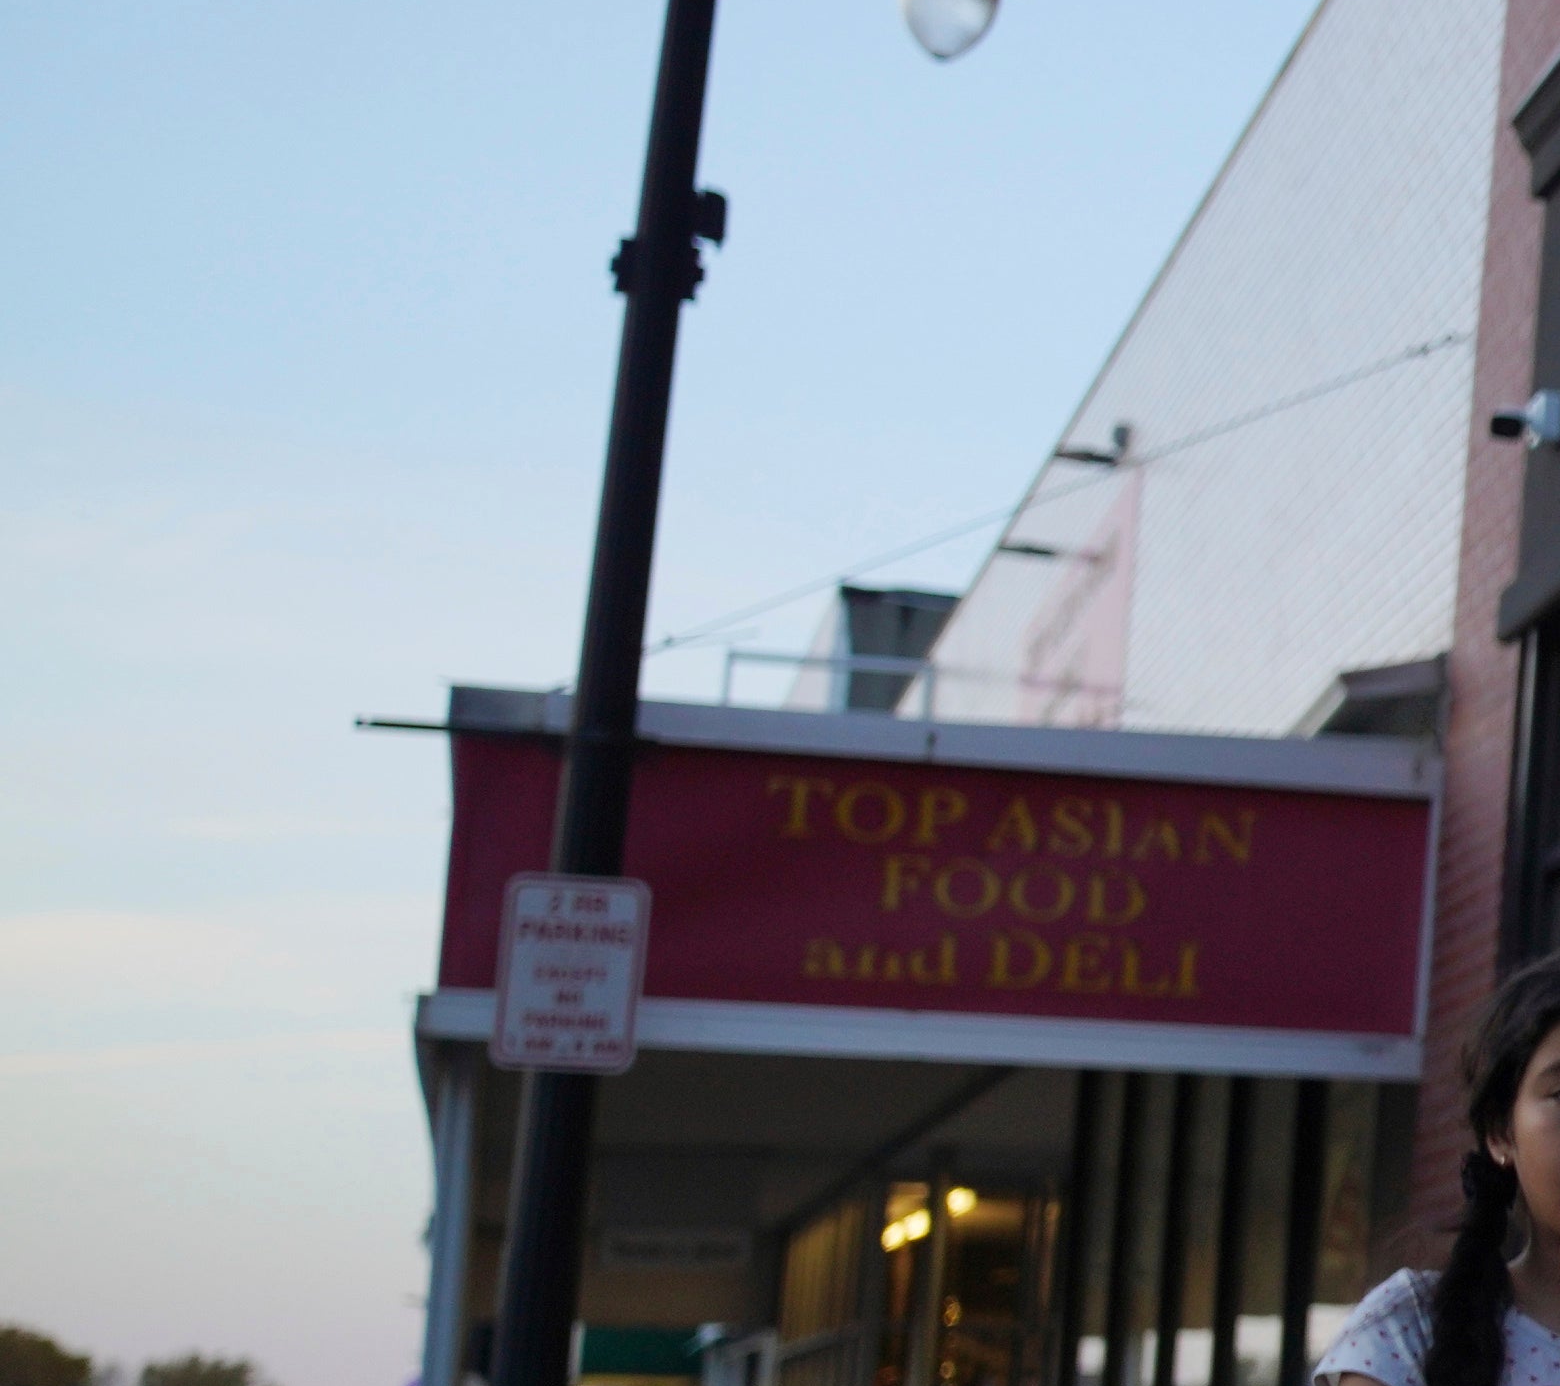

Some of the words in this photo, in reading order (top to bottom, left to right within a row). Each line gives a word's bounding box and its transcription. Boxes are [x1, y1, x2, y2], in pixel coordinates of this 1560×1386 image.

[766, 773, 969, 846] TOP
[987, 794, 1258, 865] ASIAN
[880, 853, 1148, 926] FOOD
[519, 919, 631, 946] PARKING
[802, 934, 958, 986] and
[989, 929, 1200, 998] DELI
